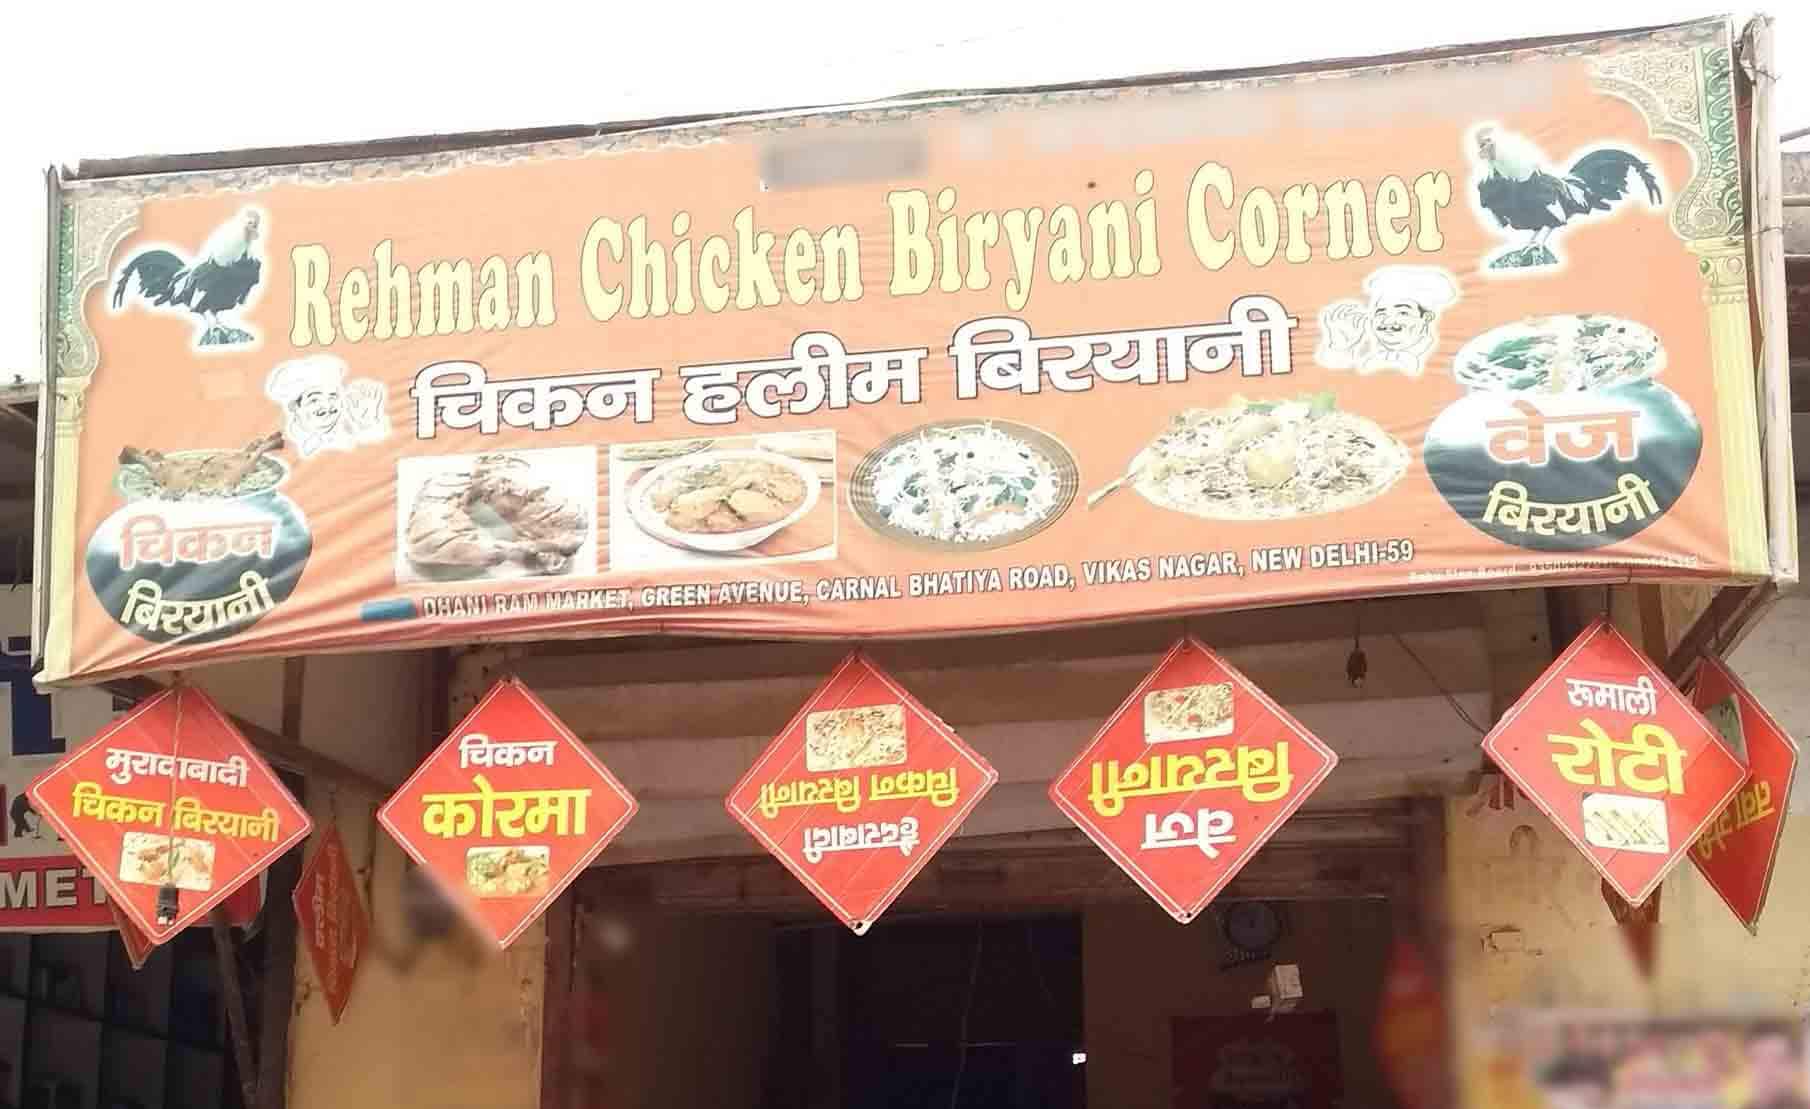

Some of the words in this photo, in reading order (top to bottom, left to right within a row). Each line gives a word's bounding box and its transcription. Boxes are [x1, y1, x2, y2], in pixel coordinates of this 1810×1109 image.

[291, 240, 557, 347] Rehman
[580, 205, 864, 322] Chicken
[886, 169, 1162, 311] Biryani
[1188, 161, 1453, 271] Corner
[410, 360, 662, 440] चिकन
[680, 331, 928, 425] हलीम
[948, 295, 1299, 401] बिरयानी
[1485, 400, 1641, 467] वेज
[1481, 474, 1660, 537] बिरयानी
[120, 515, 277, 569] चिकन
[120, 571, 276, 636] बिरयानी
[423, 595, 488, 619] DHANI
[494, 592, 538, 616] RAM
[641, 583, 711, 608] GREEN
[717, 580, 809, 608] AVENUE,
[815, 575, 902, 602] CARNAL
[909, 568, 1001, 596] BHATIYA
[1008, 565, 1075, 594] ROAD,
[1082, 559, 1153, 585] VIKAS
[1158, 551, 1245, 578] NAGAR,
[1250, 546, 1304, 573] NEW
[1565, 676, 1656, 716] रूमाली
[106, 747, 250, 788] मुरादाबादी
[458, 735, 558, 768] चिकन
[1087, 742, 1294, 816] बिरयानी
[1547, 719, 1688, 795] रोटी
[71, 781, 167, 828] चिकन
[173, 797, 281, 842] बिरयानी
[421, 774, 592, 841] कोरमा
[760, 776, 861, 818] बिरयानी
[869, 767, 960, 807] चिकन
[1140, 809, 1237, 859] वेज
